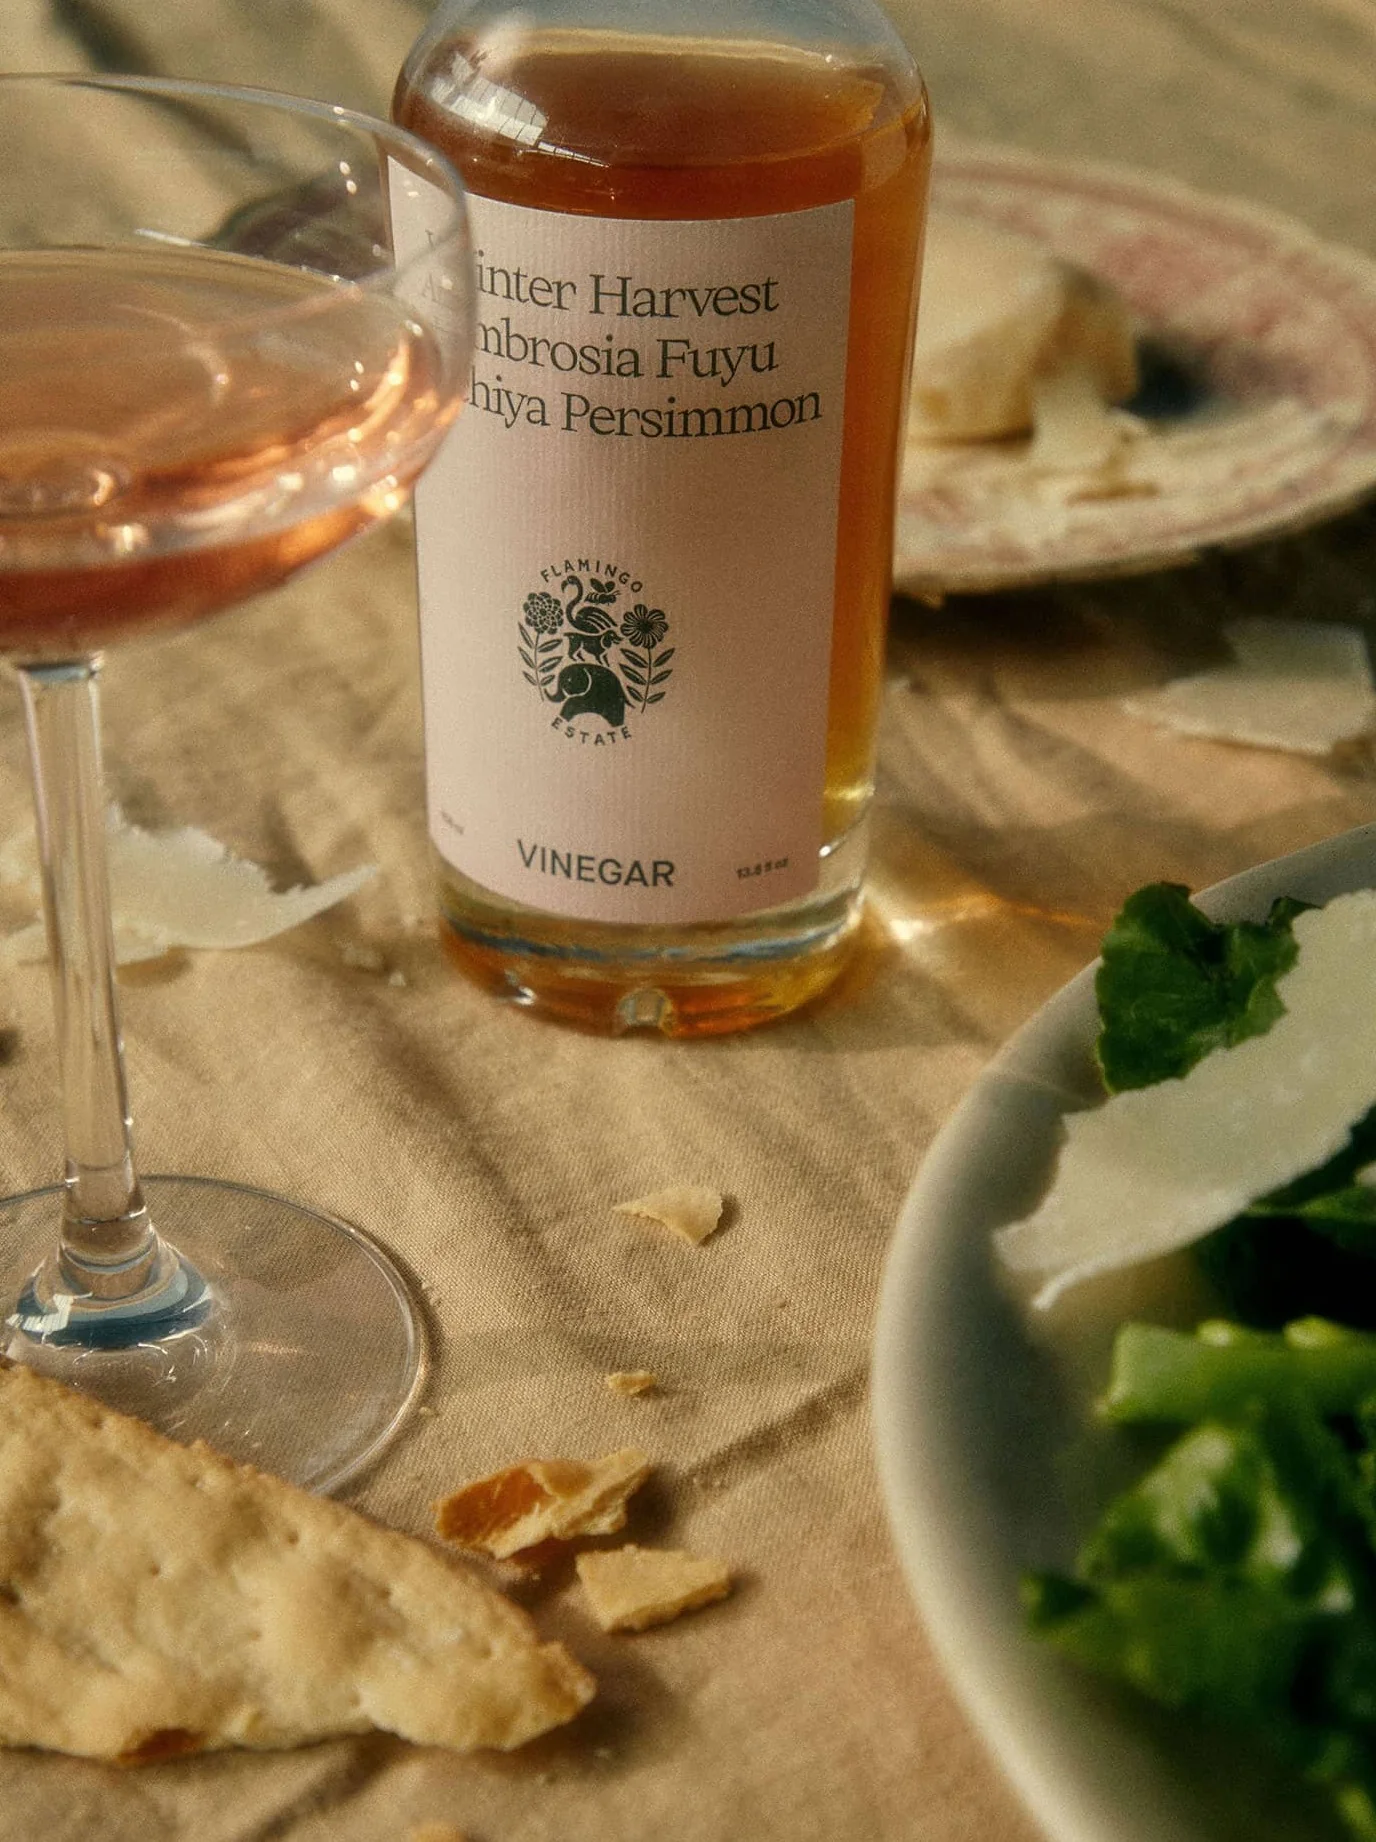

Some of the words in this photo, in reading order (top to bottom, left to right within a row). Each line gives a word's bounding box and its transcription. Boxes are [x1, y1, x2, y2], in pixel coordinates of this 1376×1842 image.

[474, 249, 578, 311] inter
[588, 273, 780, 318] Harvest
[655, 338, 779, 388] Fuyu
[468, 364, 551, 430] hiya
[560, 388, 822, 438] Persimmon
[540, 558, 644, 593] FLAMINGO
[551, 716, 632, 746] ESTATE
[517, 839, 676, 888] VINEGAR
